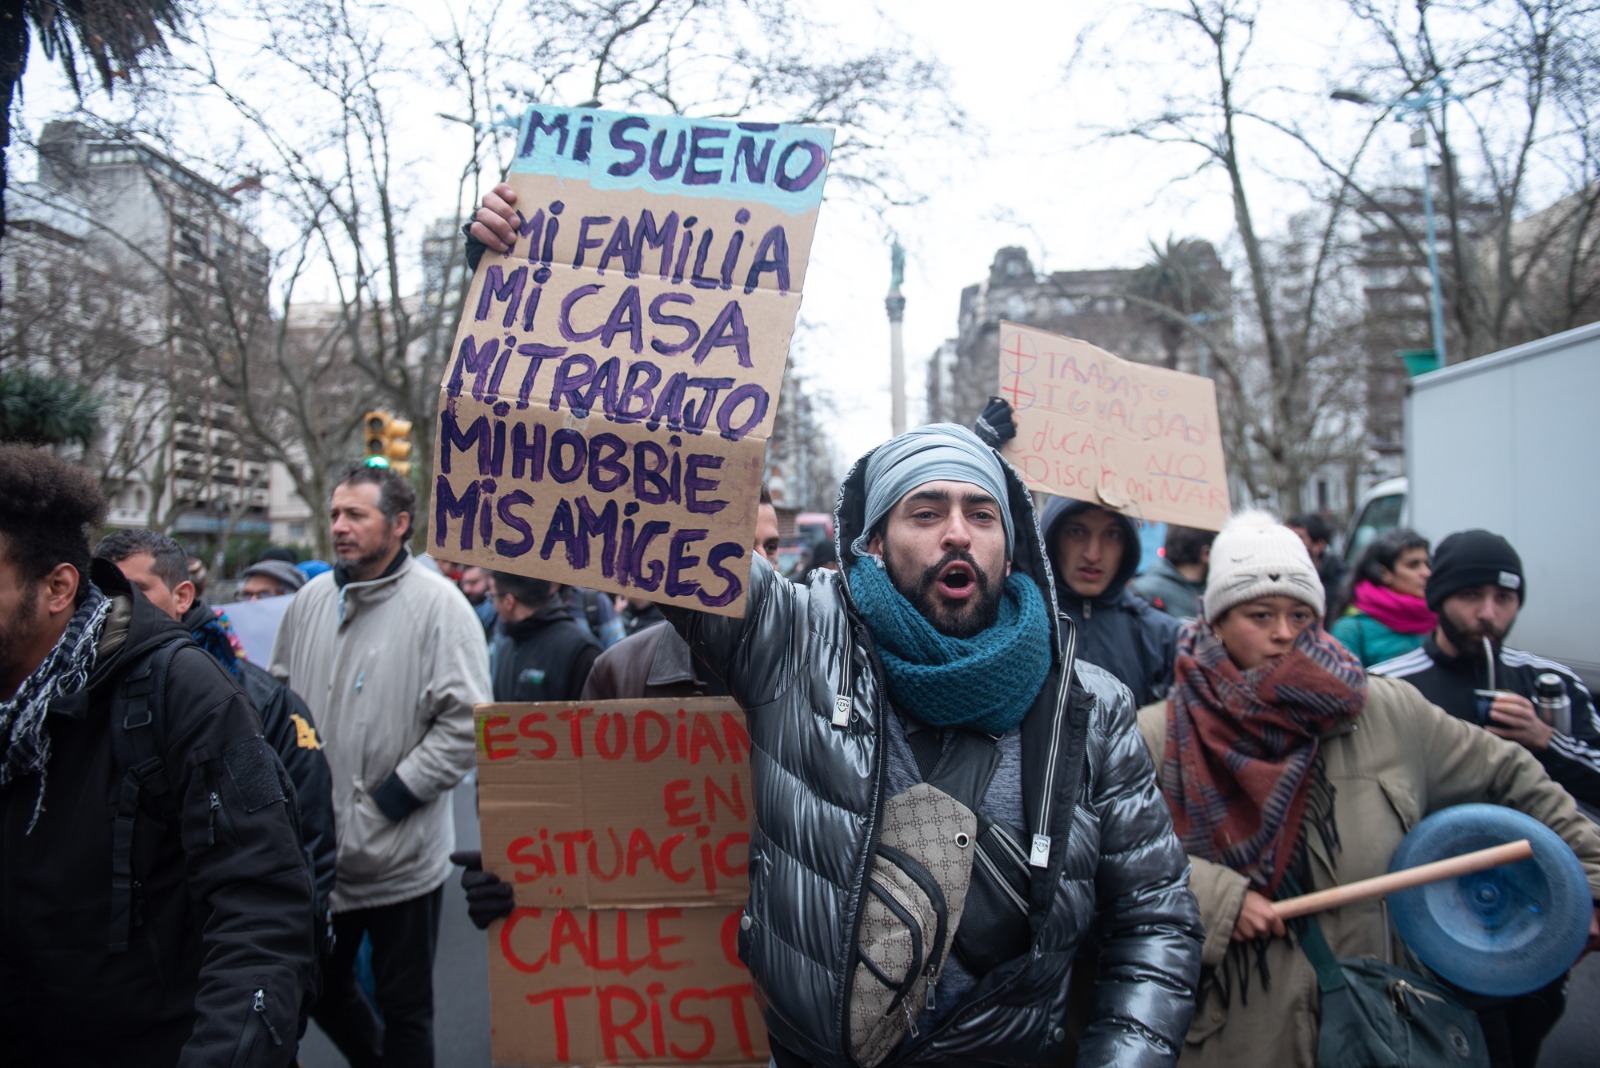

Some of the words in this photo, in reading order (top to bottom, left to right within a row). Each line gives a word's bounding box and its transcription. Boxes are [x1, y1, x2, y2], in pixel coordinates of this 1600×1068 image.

[607, 117, 826, 192] SUEÑO
[559, 283, 754, 368] CASA
[516, 343, 770, 441] TRABAJO
[1145, 452, 1207, 480] NO
[664, 773, 747, 827] EN
[501, 907, 695, 976] CALLE
